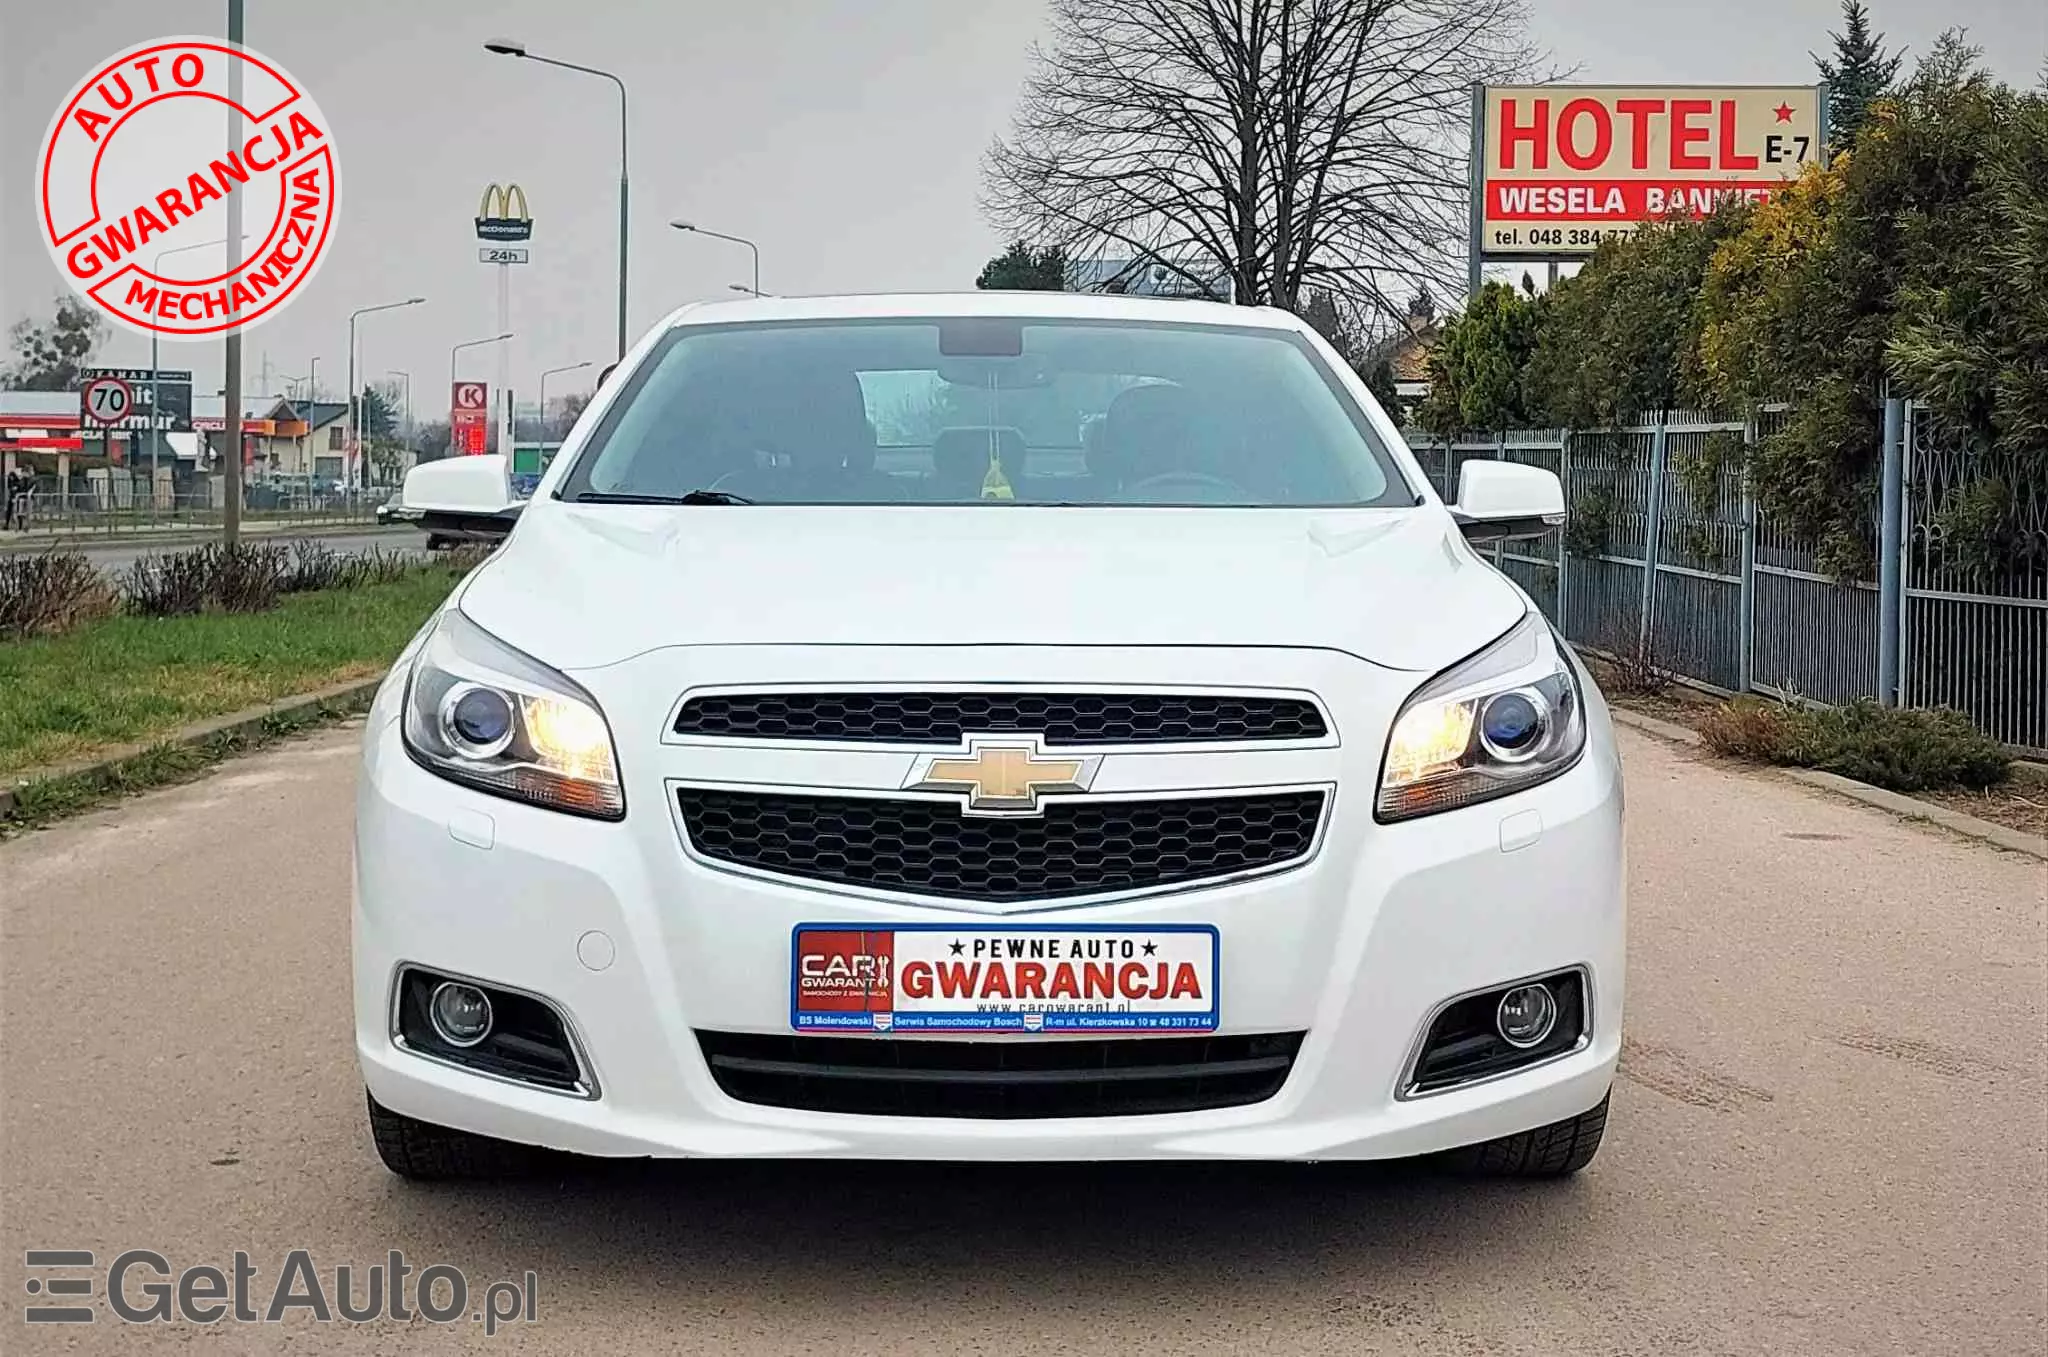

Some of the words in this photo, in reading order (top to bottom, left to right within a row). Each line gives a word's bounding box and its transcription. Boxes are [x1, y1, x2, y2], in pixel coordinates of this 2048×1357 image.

[1499, 98, 1759, 171] HOTEL
[1766, 136, 1809, 163] E-7
[1500, 187, 1625, 214] WESELA
[1645, 187, 1771, 214] BANIET
[1495, 229, 1521, 245] tel.
[1529, 229, 1562, 246] 048
[1567, 229, 1601, 246] 384
[489, 250, 518, 261] 24h
[94, 388, 125, 411] 70
[974, 940, 1060, 958] PEWNE
[1071, 939, 1134, 958] AUTO
[801, 953, 877, 977] CAR
[901, 961, 1204, 999] GWARANCJA
[895, 1015, 924, 1026] Serwis
[927, 1015, 992, 1028] Samochodowy
[994, 1015, 1022, 1026] Bosch
[1139, 1017, 1148, 1026] 10
[1159, 1017, 1170, 1026] 48
[1172, 1016, 1187, 1026] 331
[1189, 1016, 1199, 1026] 73
[1201, 1016, 1212, 1026] 44
